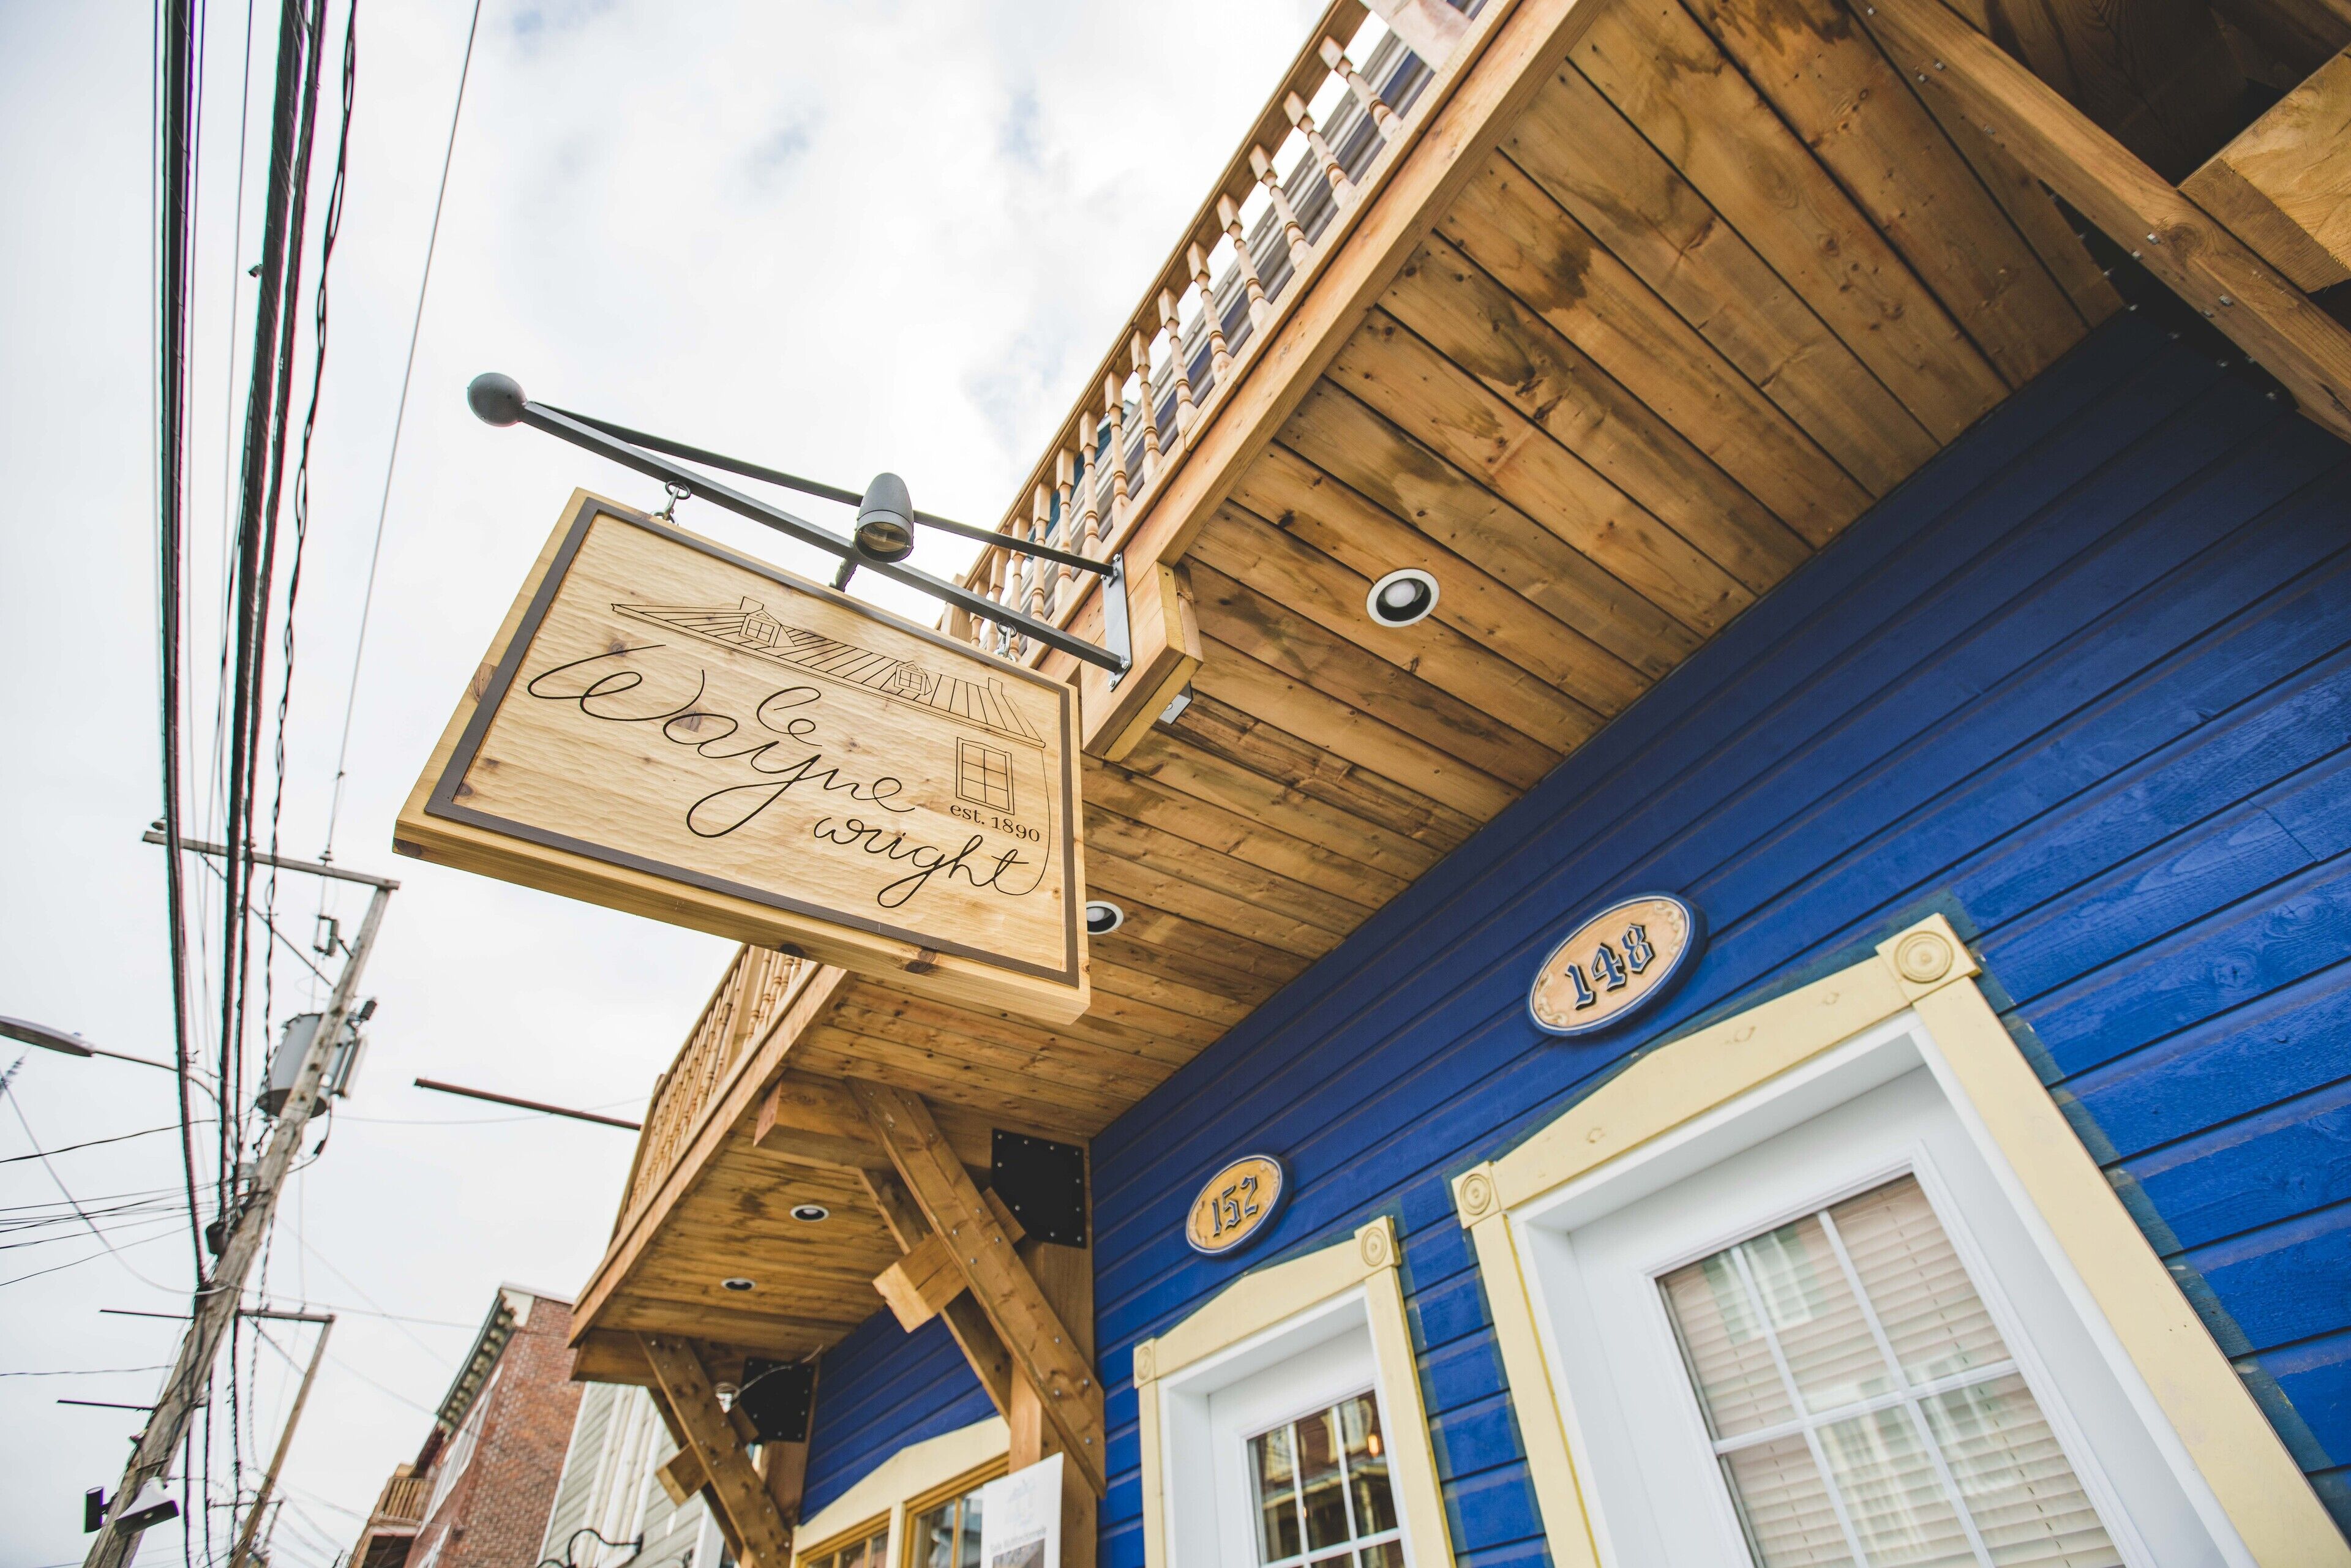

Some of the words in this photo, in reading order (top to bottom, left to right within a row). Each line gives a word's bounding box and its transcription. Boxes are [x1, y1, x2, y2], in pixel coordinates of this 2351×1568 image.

[527, 643, 915, 838] Wayne
[814, 817, 1029, 908] wright
[950, 805, 985, 825] est.
[991, 817, 1040, 842] 1890
[1565, 923, 1654, 1010] 148
[1212, 1176, 1258, 1237] 152
